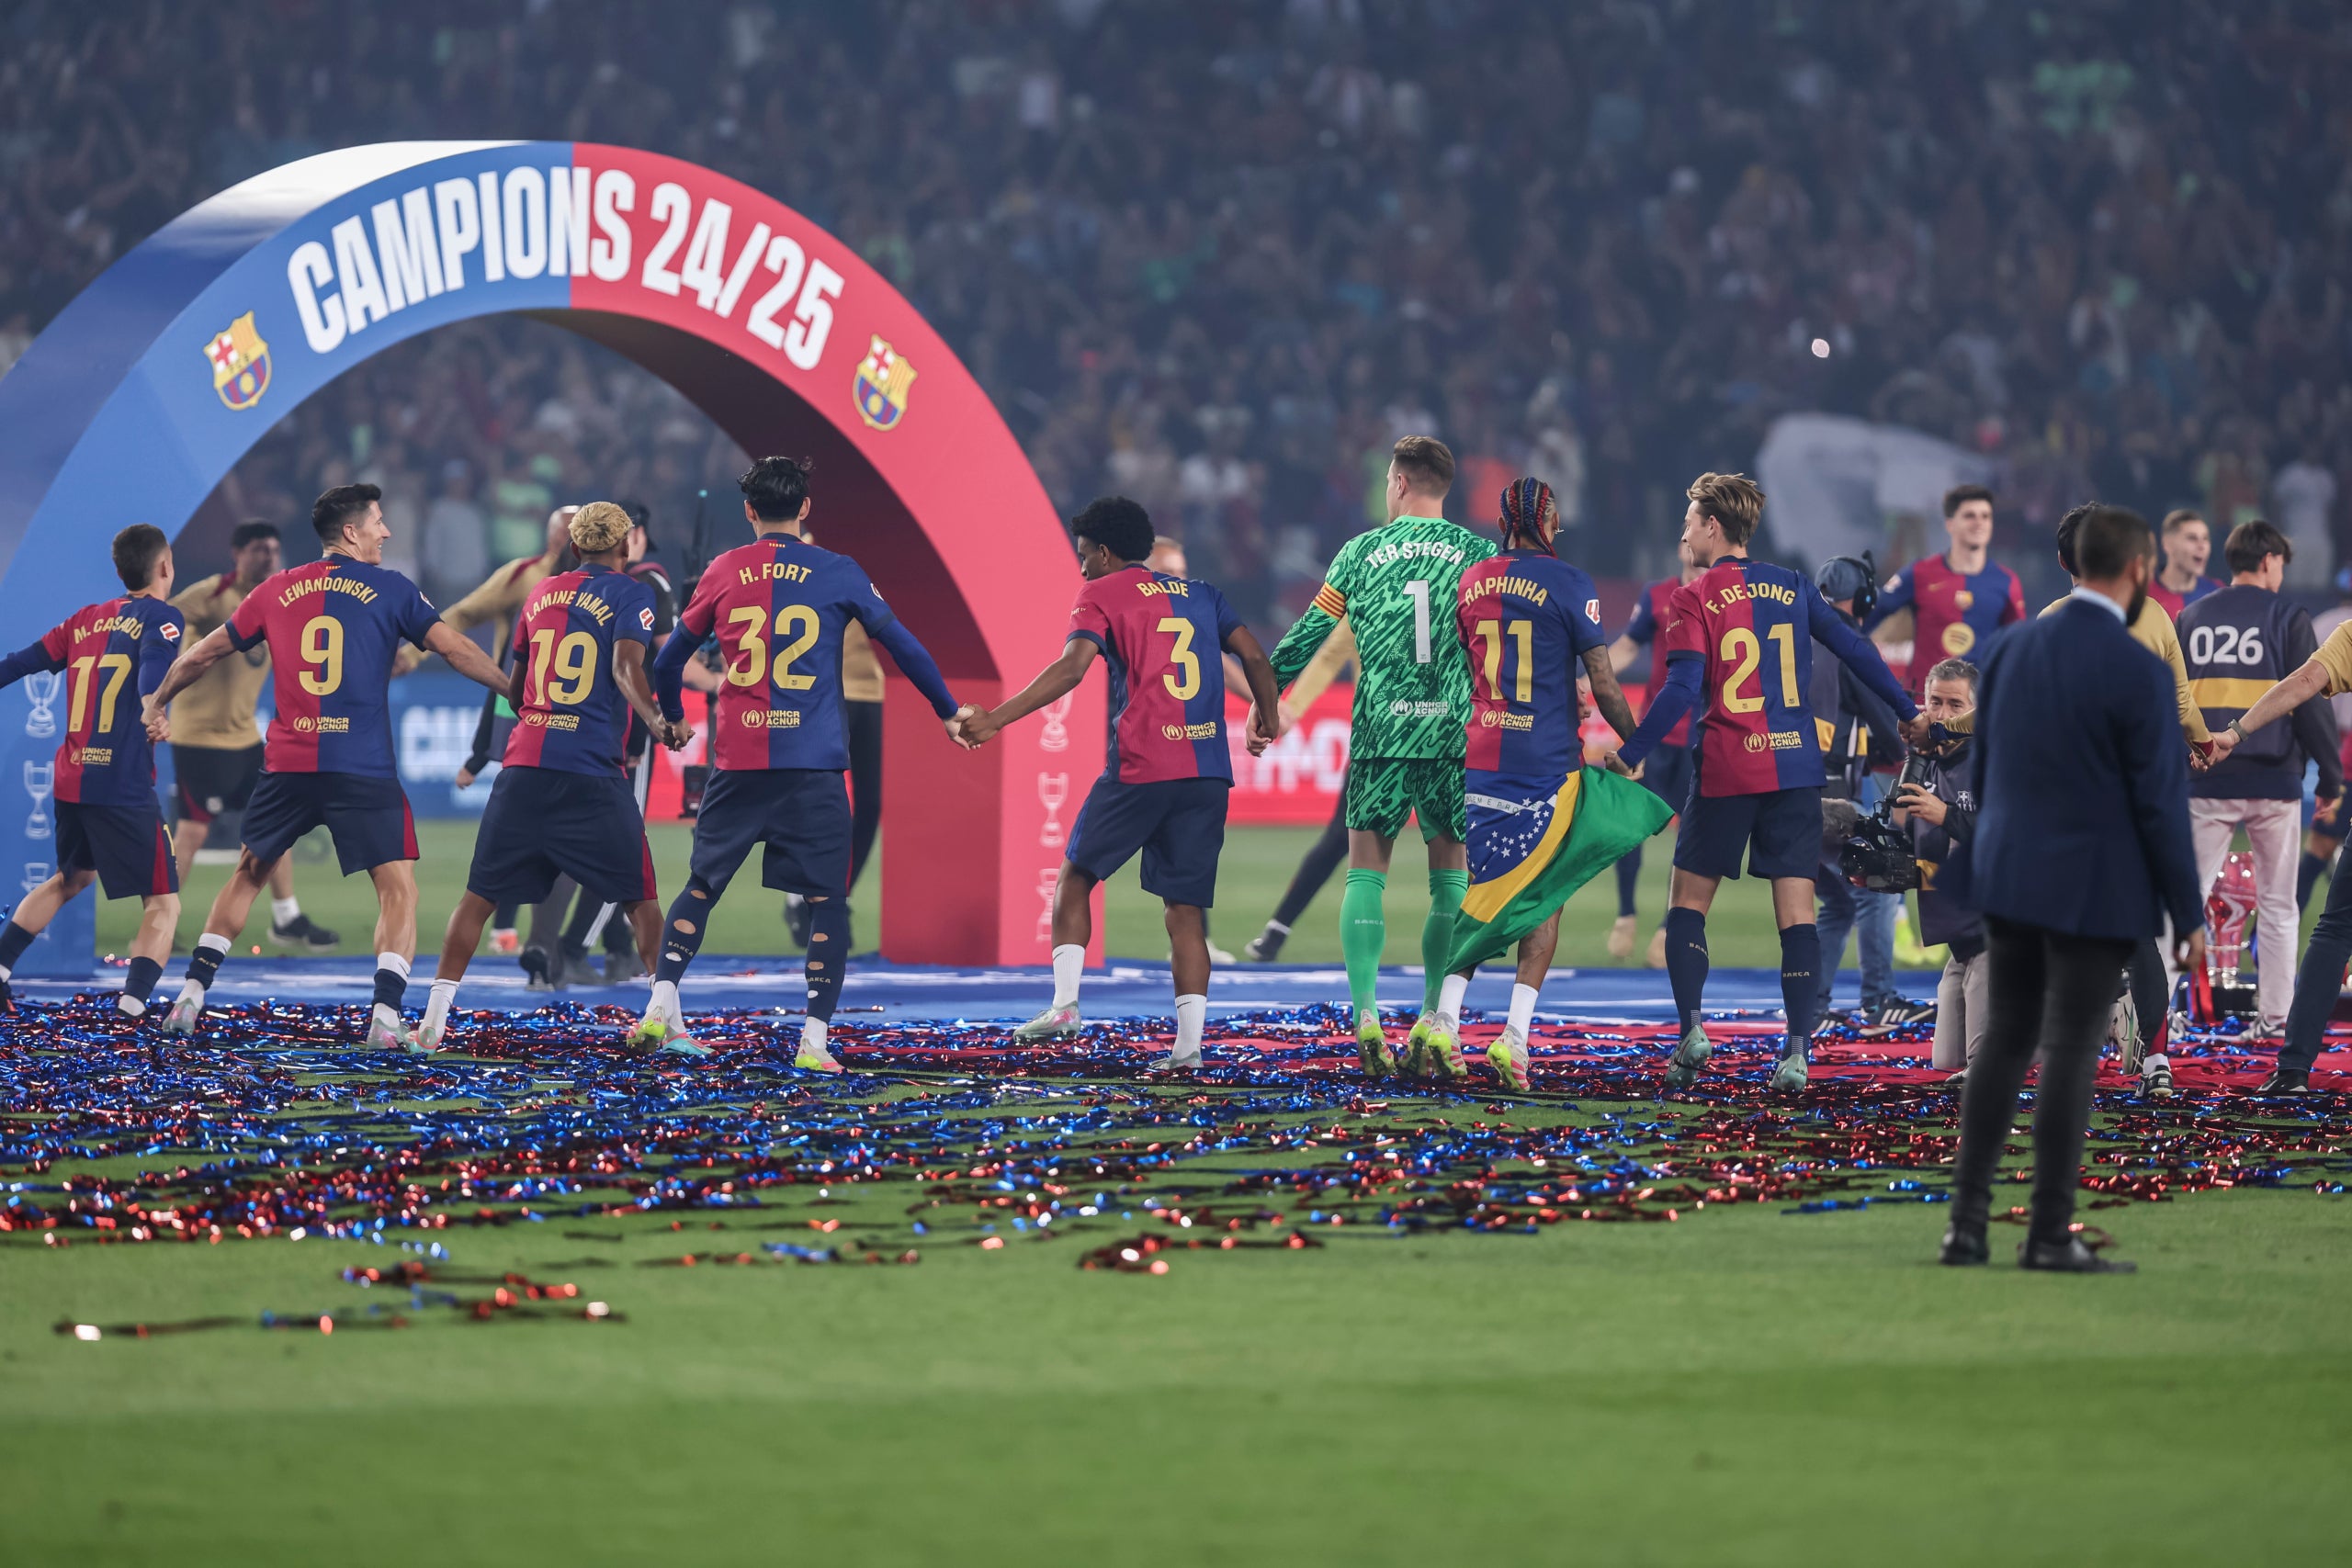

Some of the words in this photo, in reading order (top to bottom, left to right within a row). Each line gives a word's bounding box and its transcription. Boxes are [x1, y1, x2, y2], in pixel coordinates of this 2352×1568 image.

[286, 165, 637, 355] CAMPIONS
[641, 181, 845, 371] 24/25
[1365, 543, 1398, 570] TER
[1401, 542, 1465, 565] STEGEN
[739, 567, 759, 585] H.
[762, 563, 812, 583] FORT
[278, 577, 378, 607] LEWANDOWSKI
[1136, 581, 1189, 598] BALDE
[1464, 576, 1548, 607] RAPHINHA
[1705, 600, 1725, 615] F.
[1720, 584, 1746, 604] DE
[1747, 582, 1796, 606] JONG
[526, 591, 576, 623] LAMINE
[575, 592, 614, 626] YAMAL
[1403, 580, 1430, 663] 1
[74, 626, 90, 644] M.
[94, 615, 143, 639] CASADO
[299, 615, 344, 695] 9
[727, 604, 820, 691] 32
[1156, 617, 1201, 701] 3
[2189, 626, 2264, 666] 026
[530, 628, 597, 705] 19
[1476, 620, 1532, 702] 11
[1720, 623, 1801, 714] 21
[69, 654, 131, 732] 17
[547, 721, 578, 730] ACNUR
[548, 715, 580, 723] UNHCR
[766, 710, 800, 718] UNHCR
[766, 717, 800, 726] ACNUR
[1183, 721, 1216, 731] UNHCR
[1500, 718, 1532, 728] ACNUR
[1501, 711, 1534, 721] UNHCR
[1186, 728, 1216, 738] ACNUR
[1768, 731, 1799, 739] UNHCR
[1770, 739, 1802, 747] ACNUR
[81, 754, 111, 762] ACNUR
[82, 747, 112, 755] UNHCR
